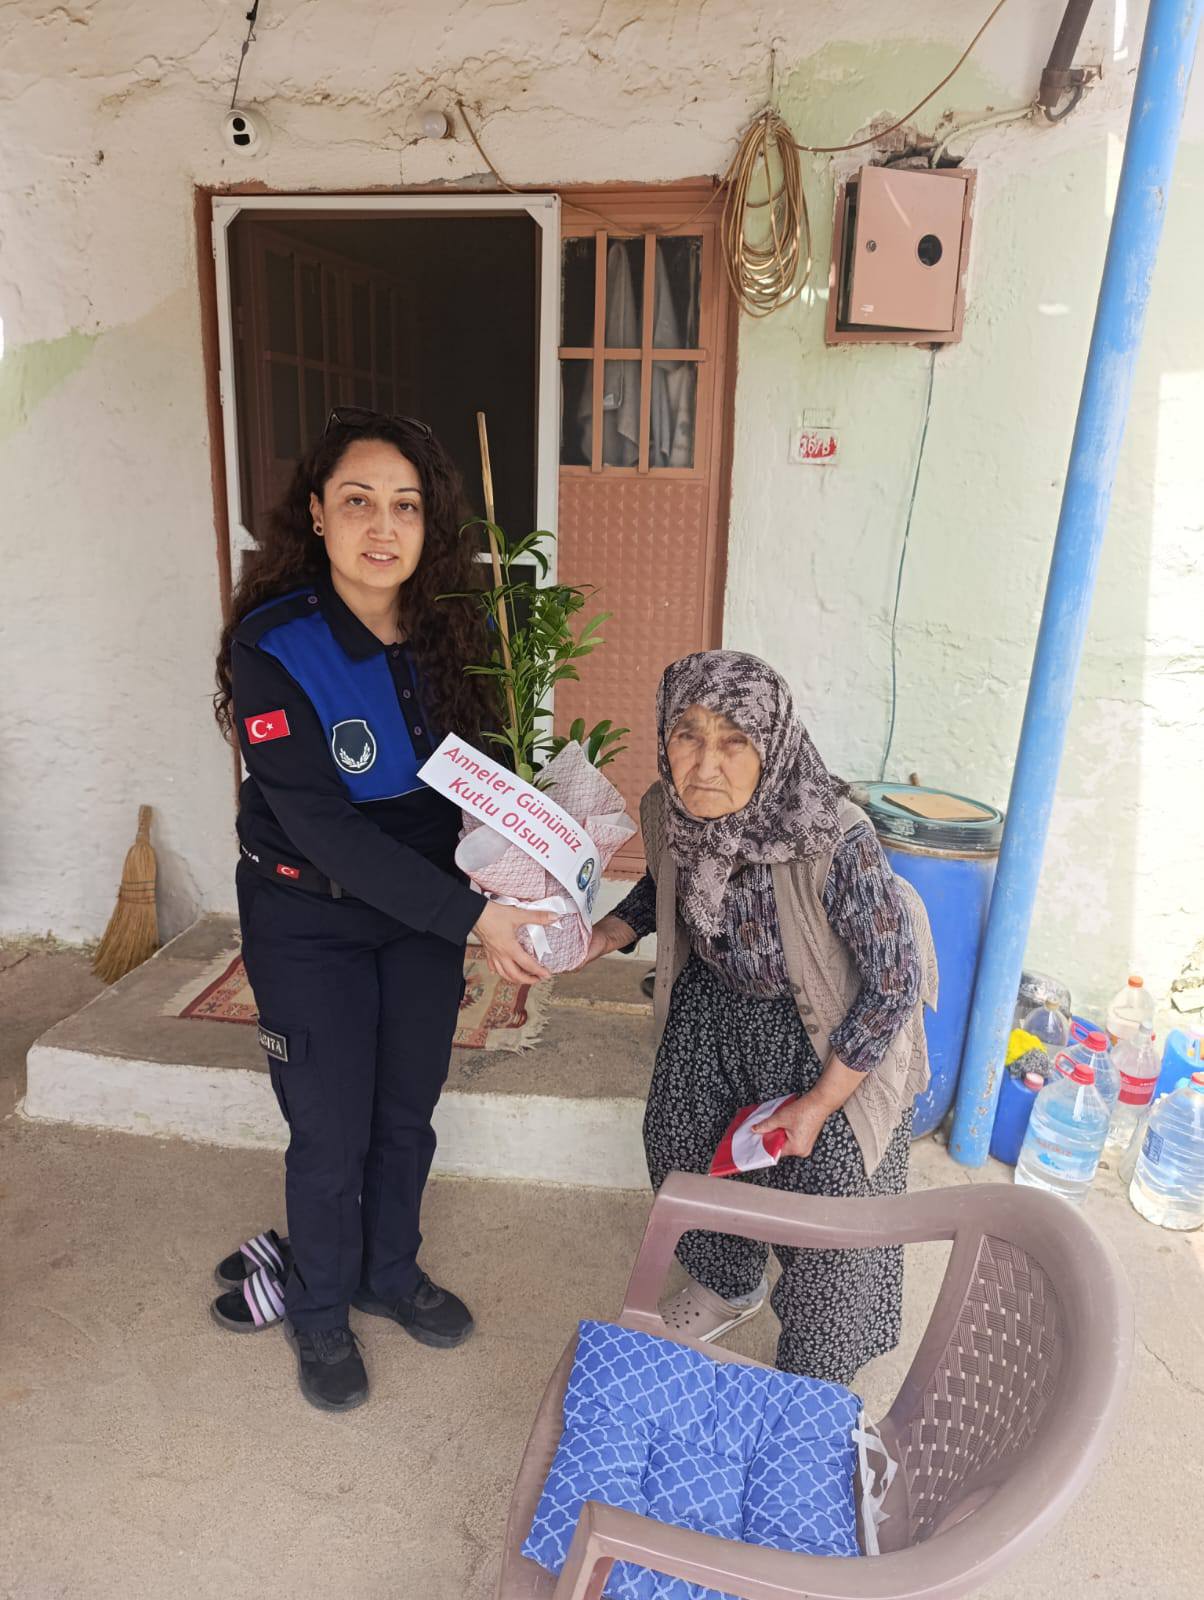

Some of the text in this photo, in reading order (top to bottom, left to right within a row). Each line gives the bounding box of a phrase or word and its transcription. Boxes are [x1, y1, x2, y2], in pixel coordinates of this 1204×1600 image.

[443, 747, 583, 853] Anneler Gününüz
[448, 777, 551, 859] Kutlu Olsun.
